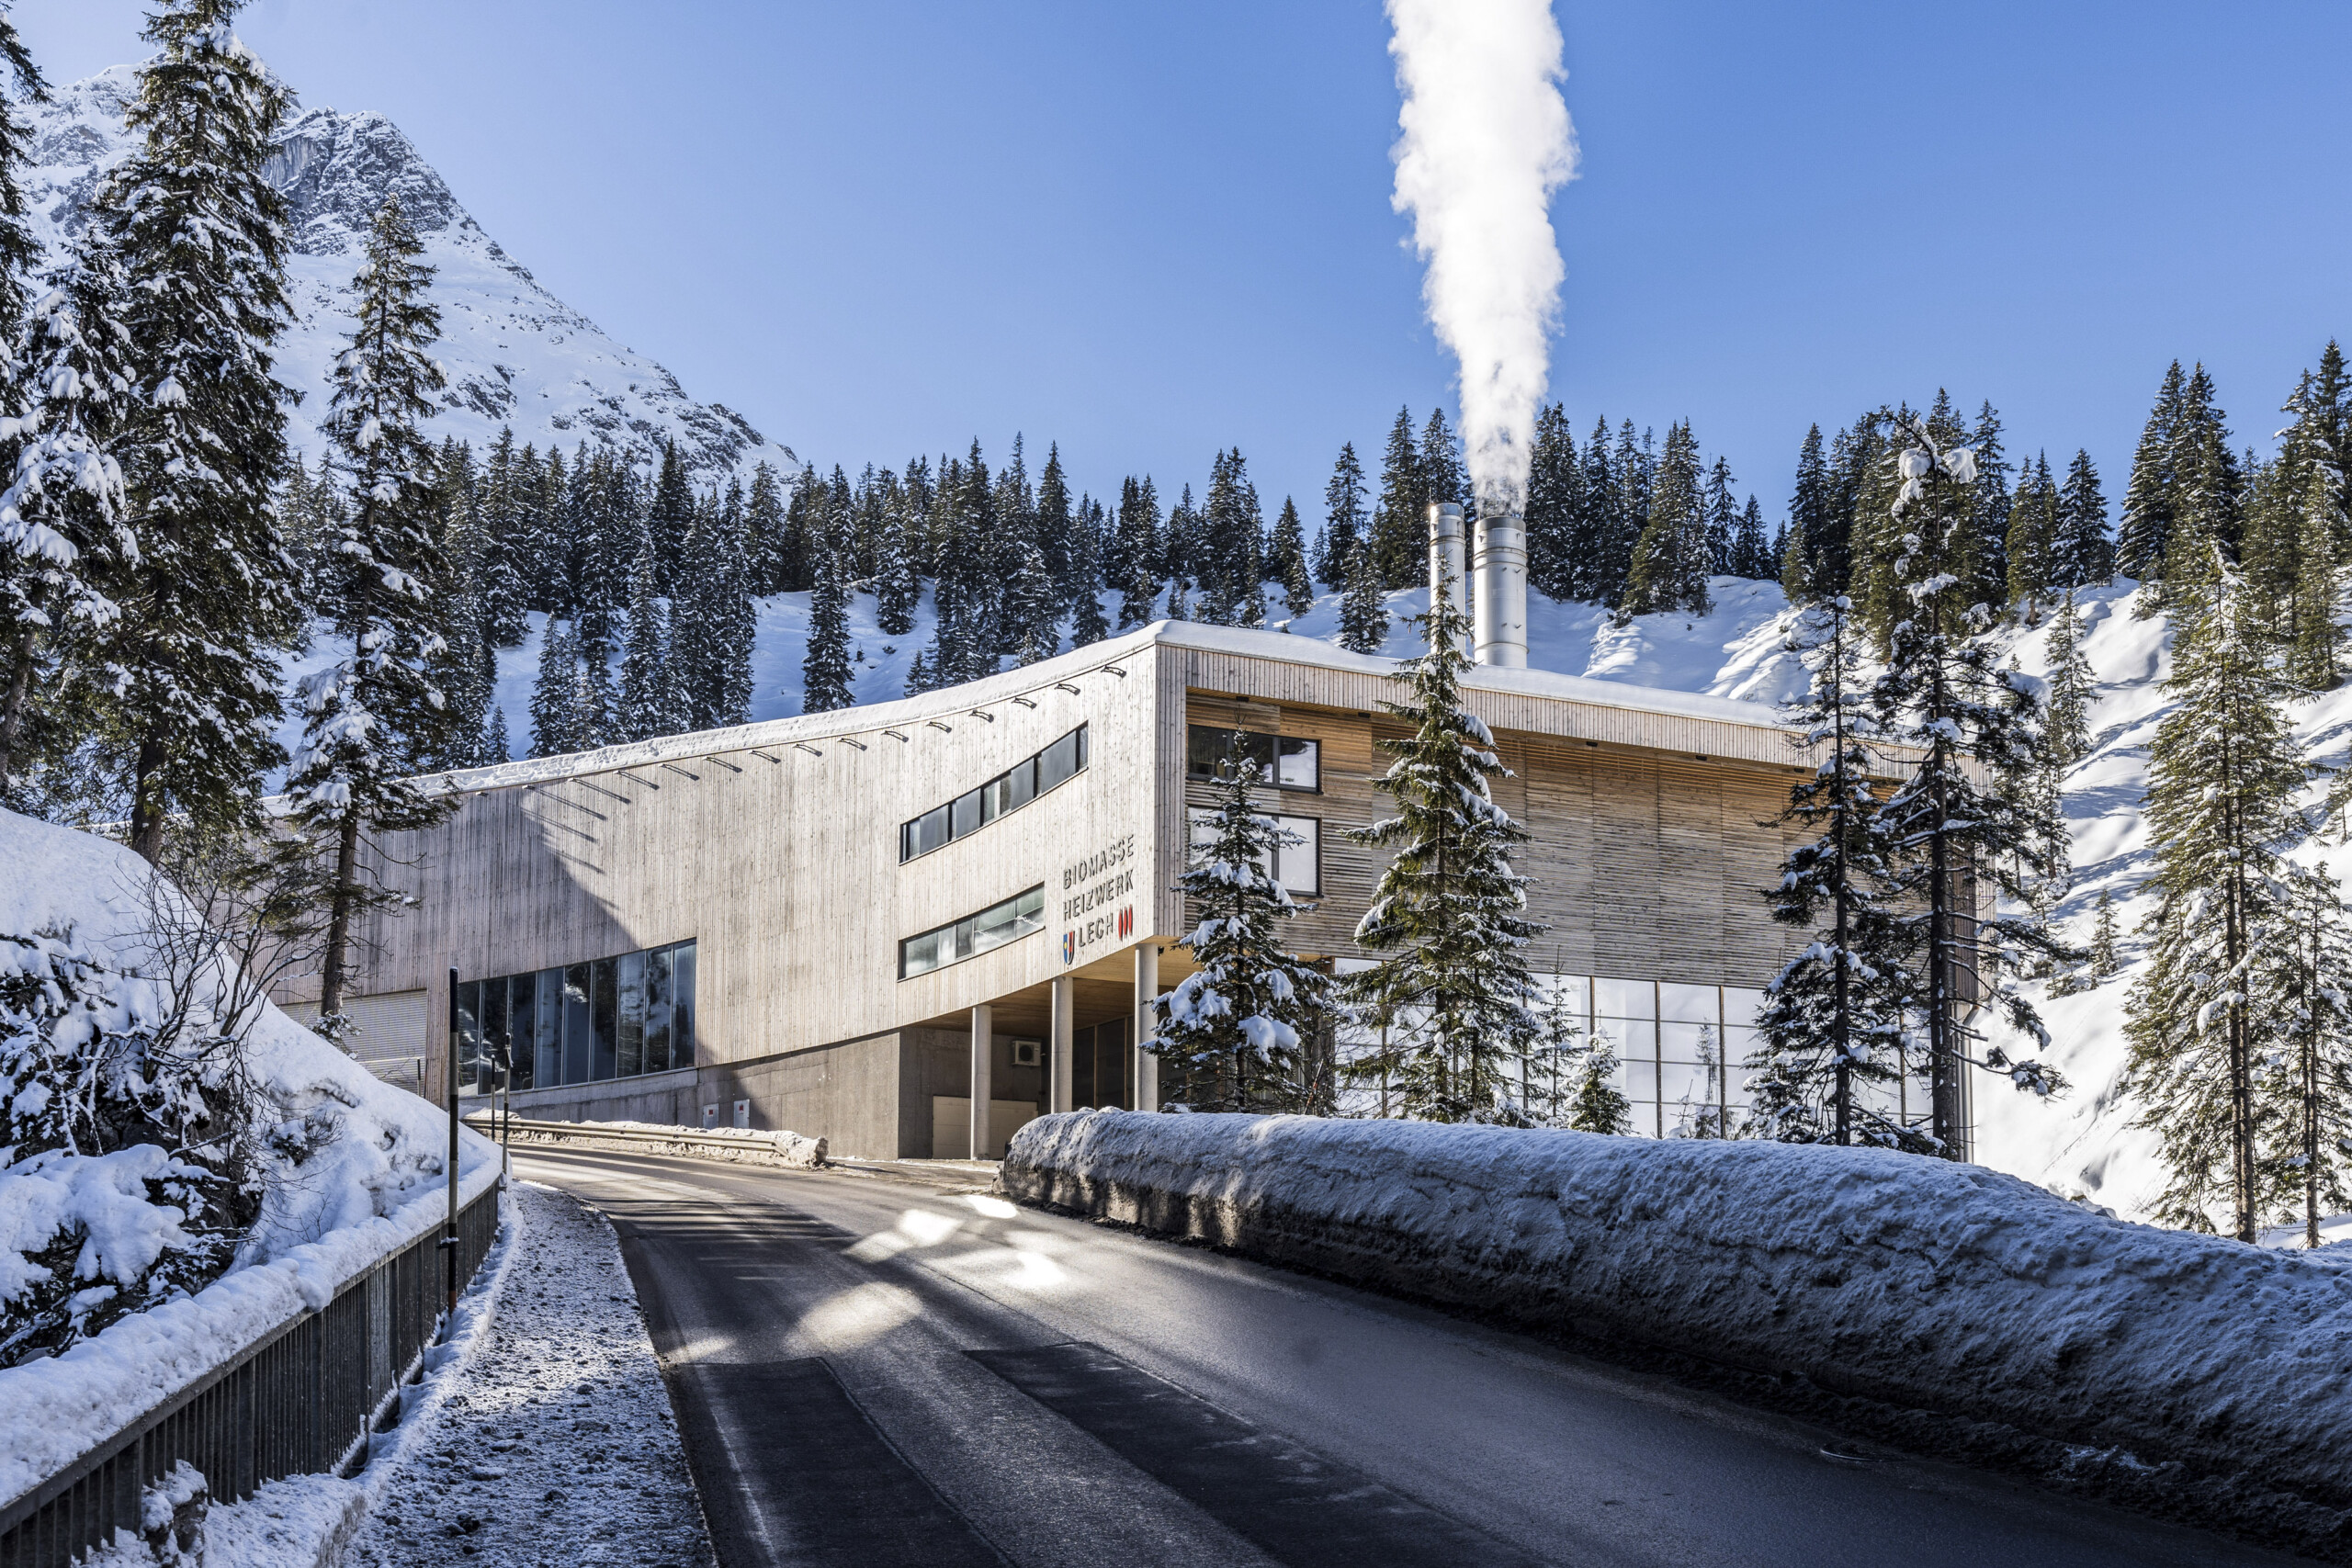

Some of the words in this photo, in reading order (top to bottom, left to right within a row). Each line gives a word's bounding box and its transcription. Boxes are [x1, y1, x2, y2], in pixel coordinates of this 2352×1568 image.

[1063, 834, 1134, 889] BIOMASSE
[1063, 869, 1134, 921] HEIZWERK
[1079, 912, 1114, 947] LECH
